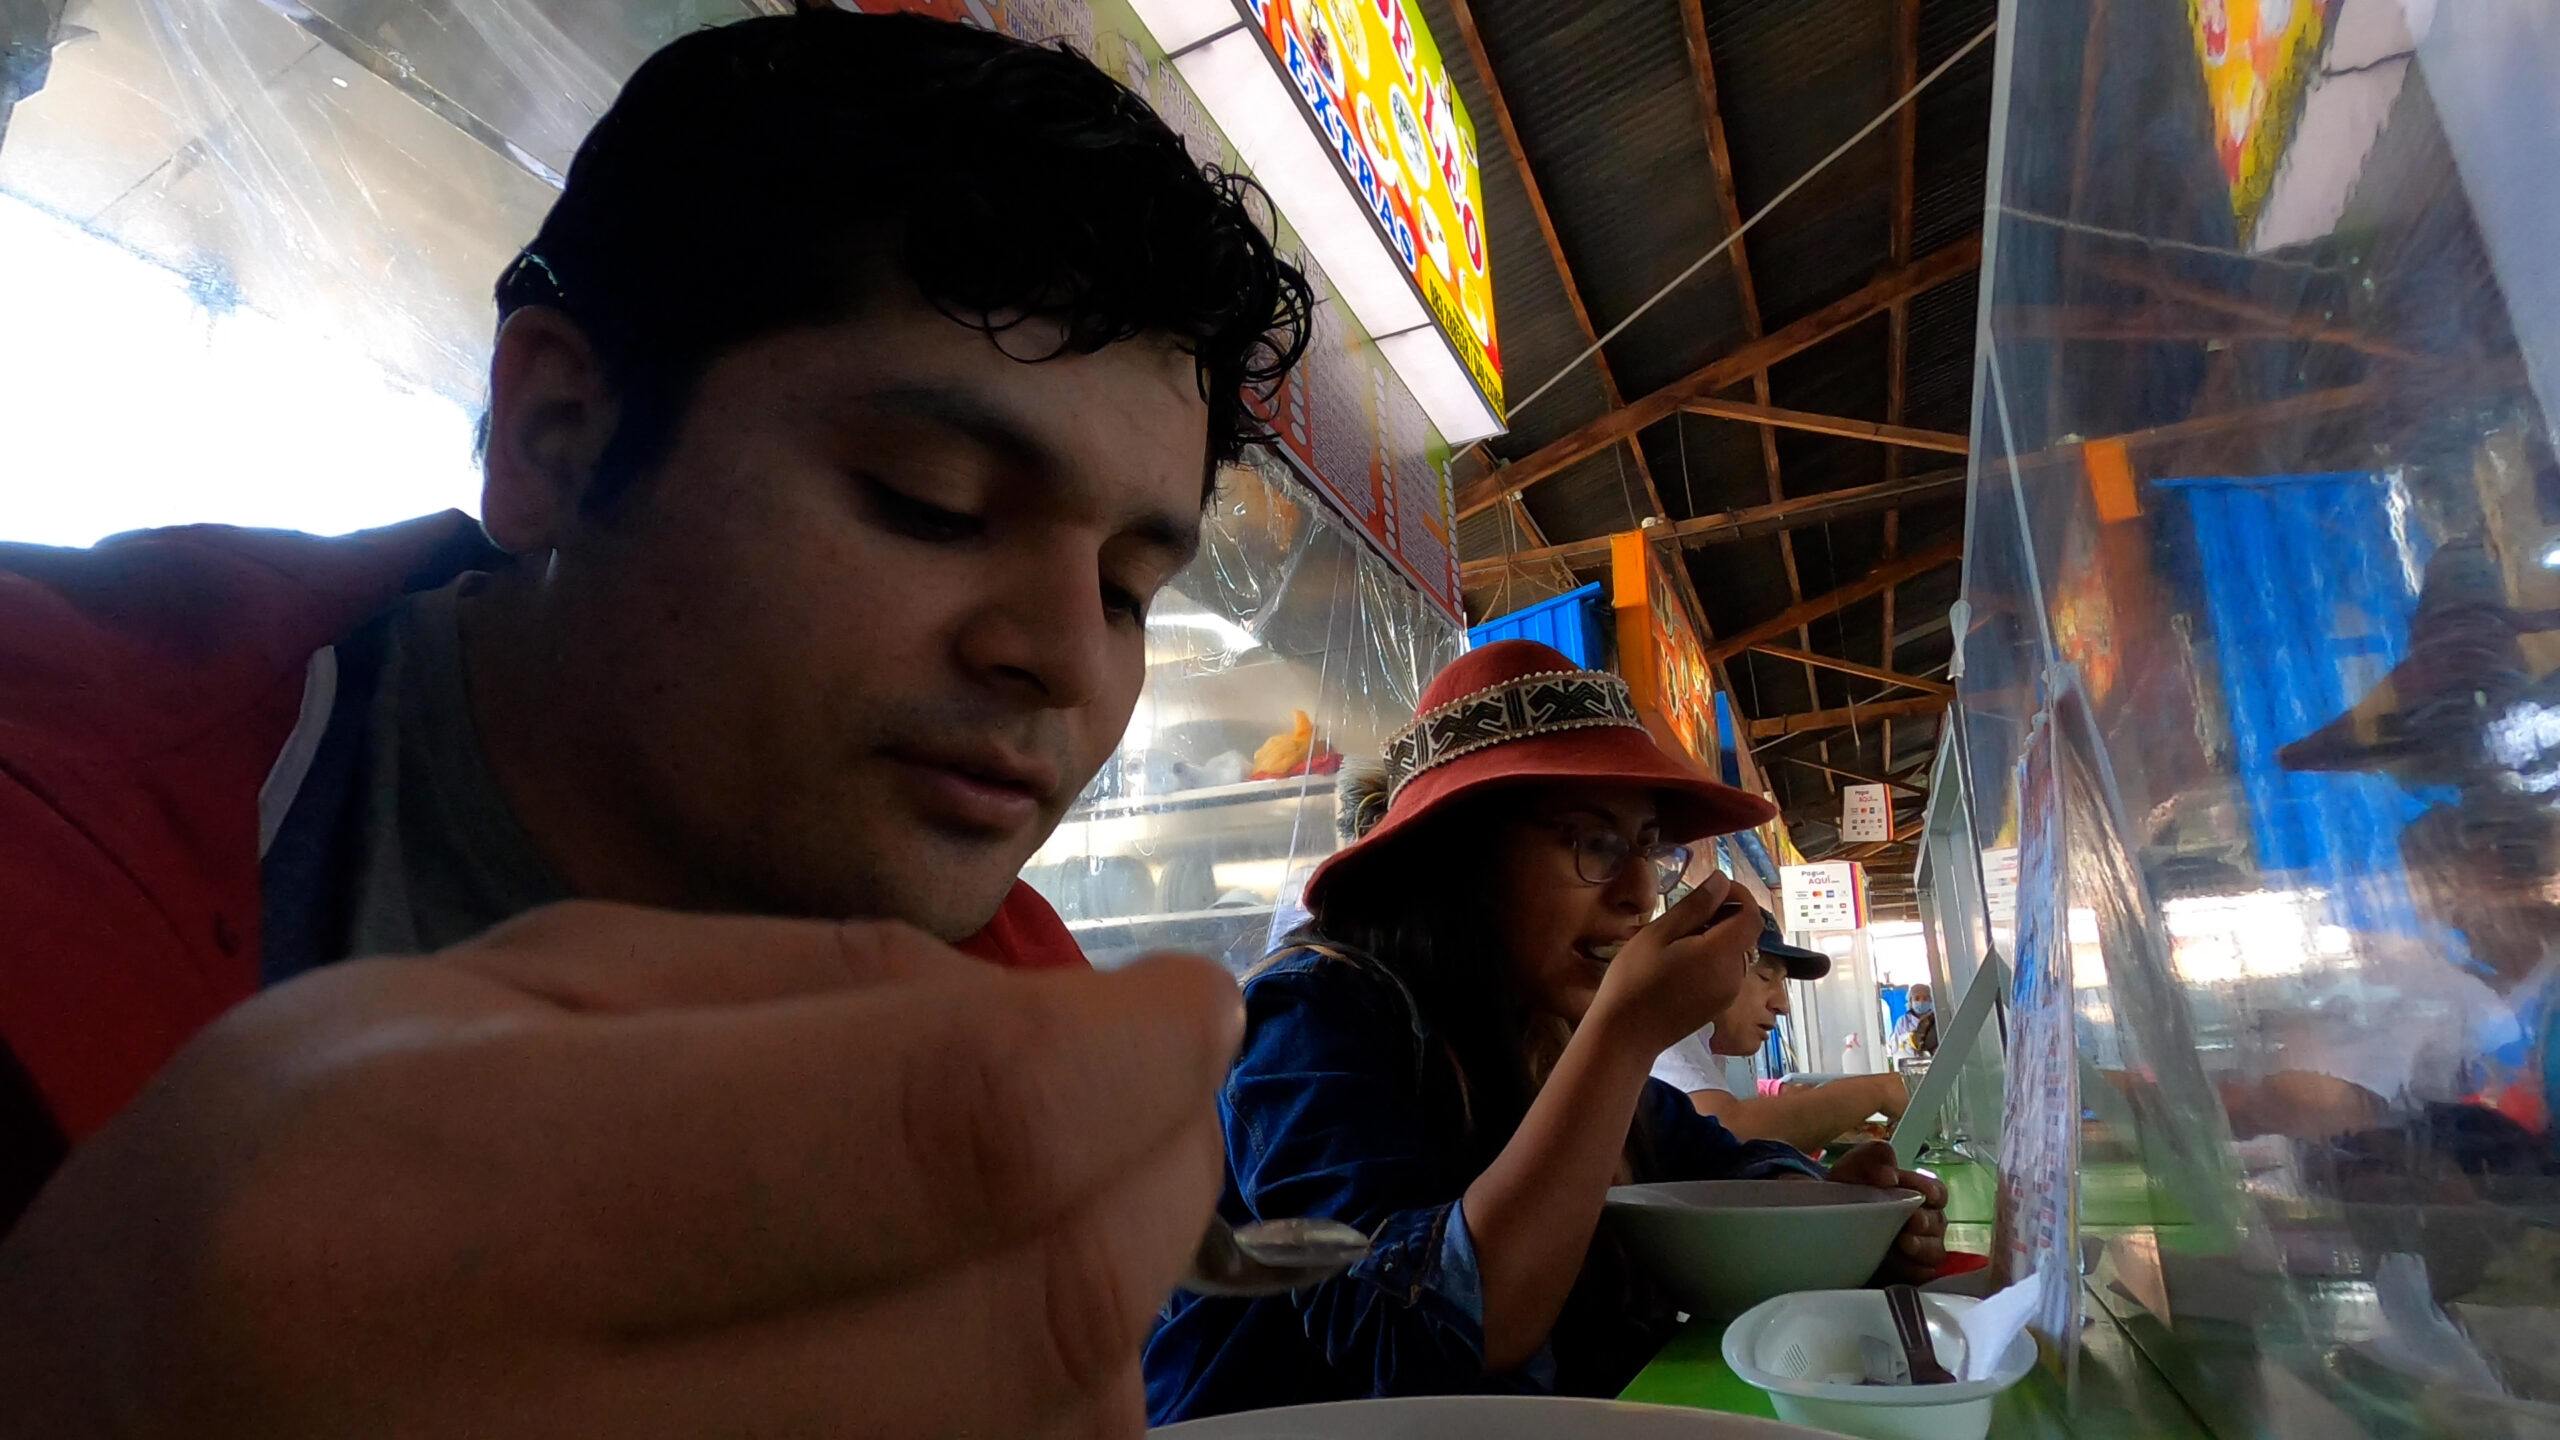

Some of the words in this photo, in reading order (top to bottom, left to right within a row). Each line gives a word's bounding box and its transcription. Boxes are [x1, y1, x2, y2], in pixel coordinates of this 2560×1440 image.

[1376, 0, 1413, 88] E
[1157, 60, 1223, 159] FRIJOLES
[1286, 31, 1415, 267] EXTRAS
[1801, 870, 1825, 878] Pague
